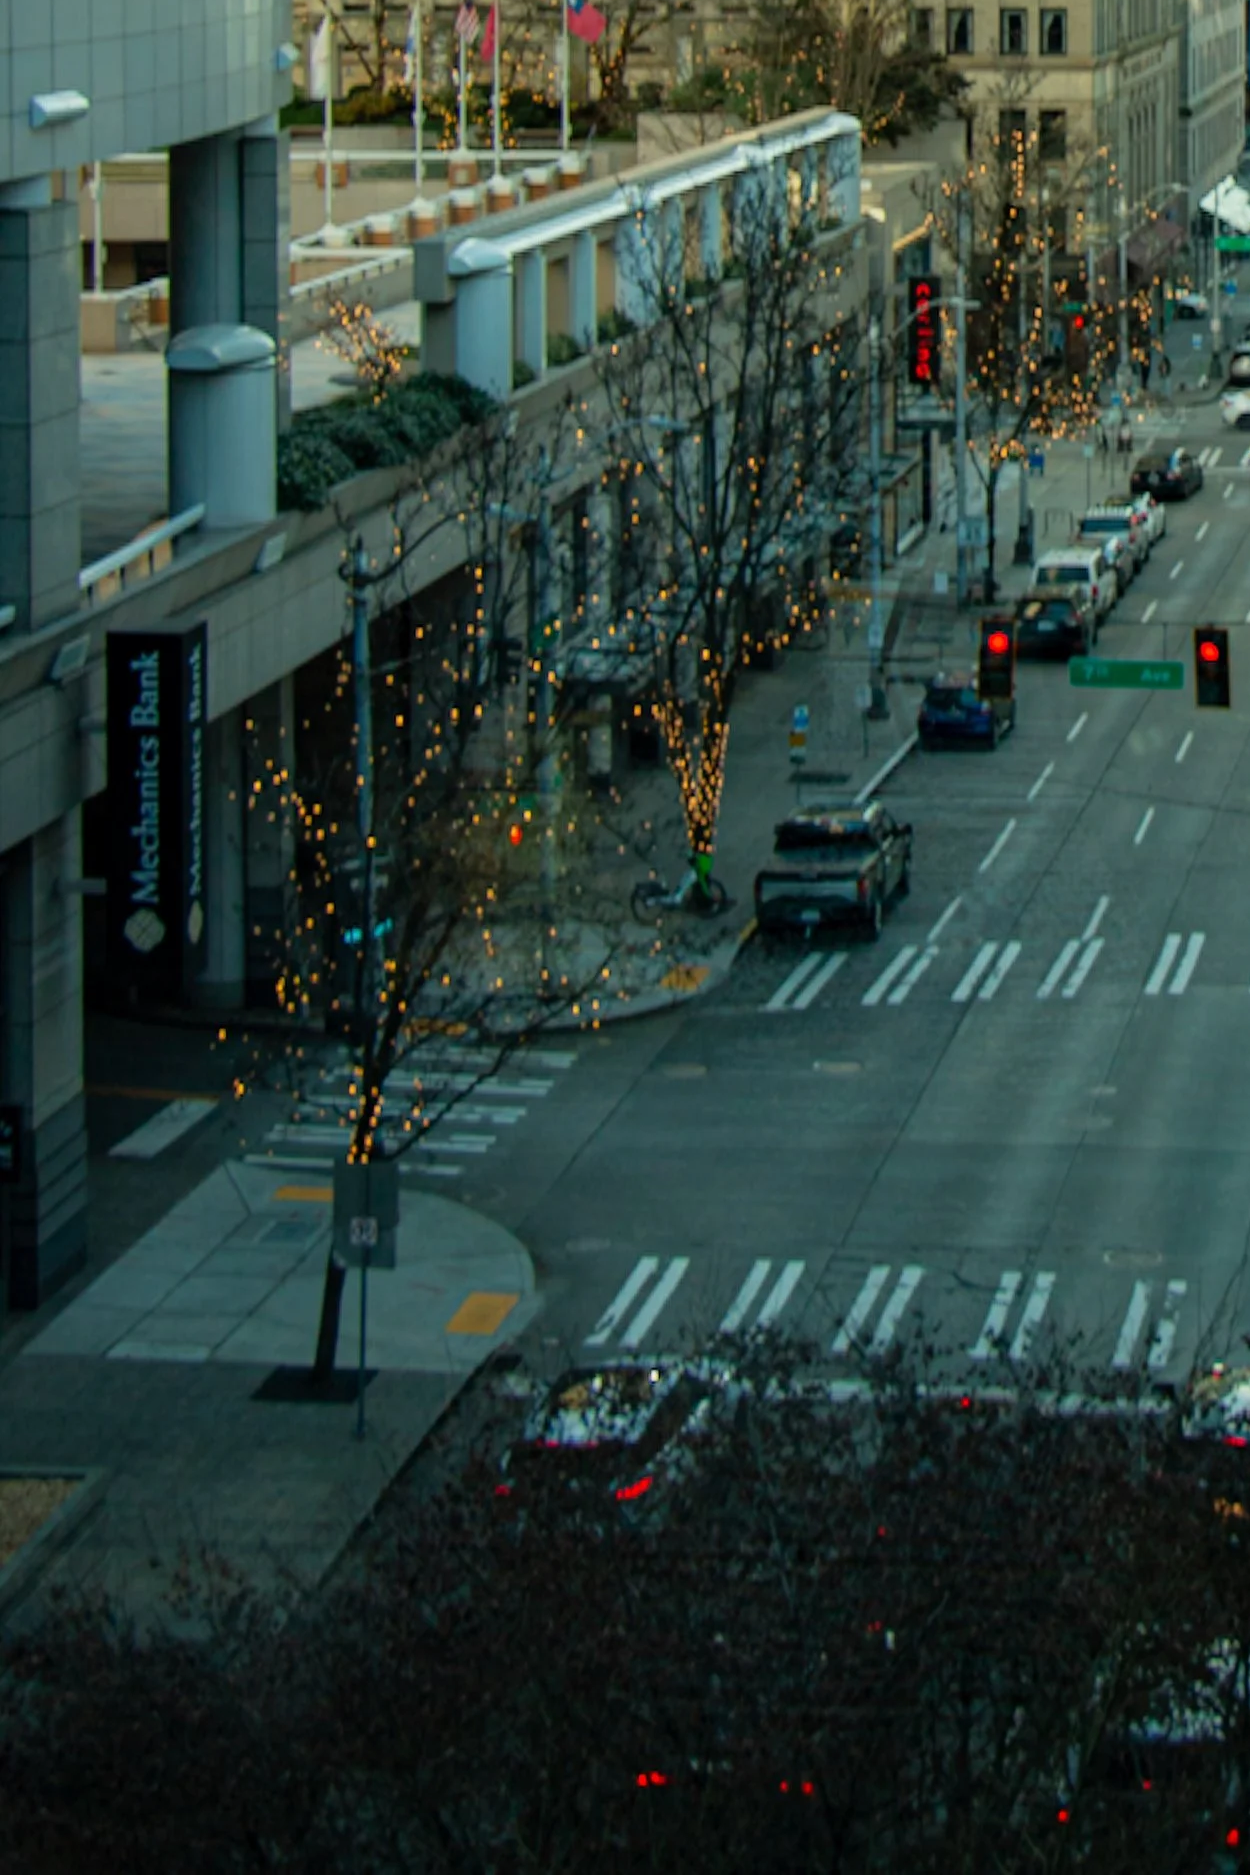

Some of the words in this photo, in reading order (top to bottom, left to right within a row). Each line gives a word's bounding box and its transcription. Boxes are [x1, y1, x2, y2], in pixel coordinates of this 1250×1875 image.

[130, 650, 160, 727] Bank
[188, 643, 202, 722] Bank
[130, 736, 160, 904] Mechanics
[189, 728, 202, 896] Mechanics
